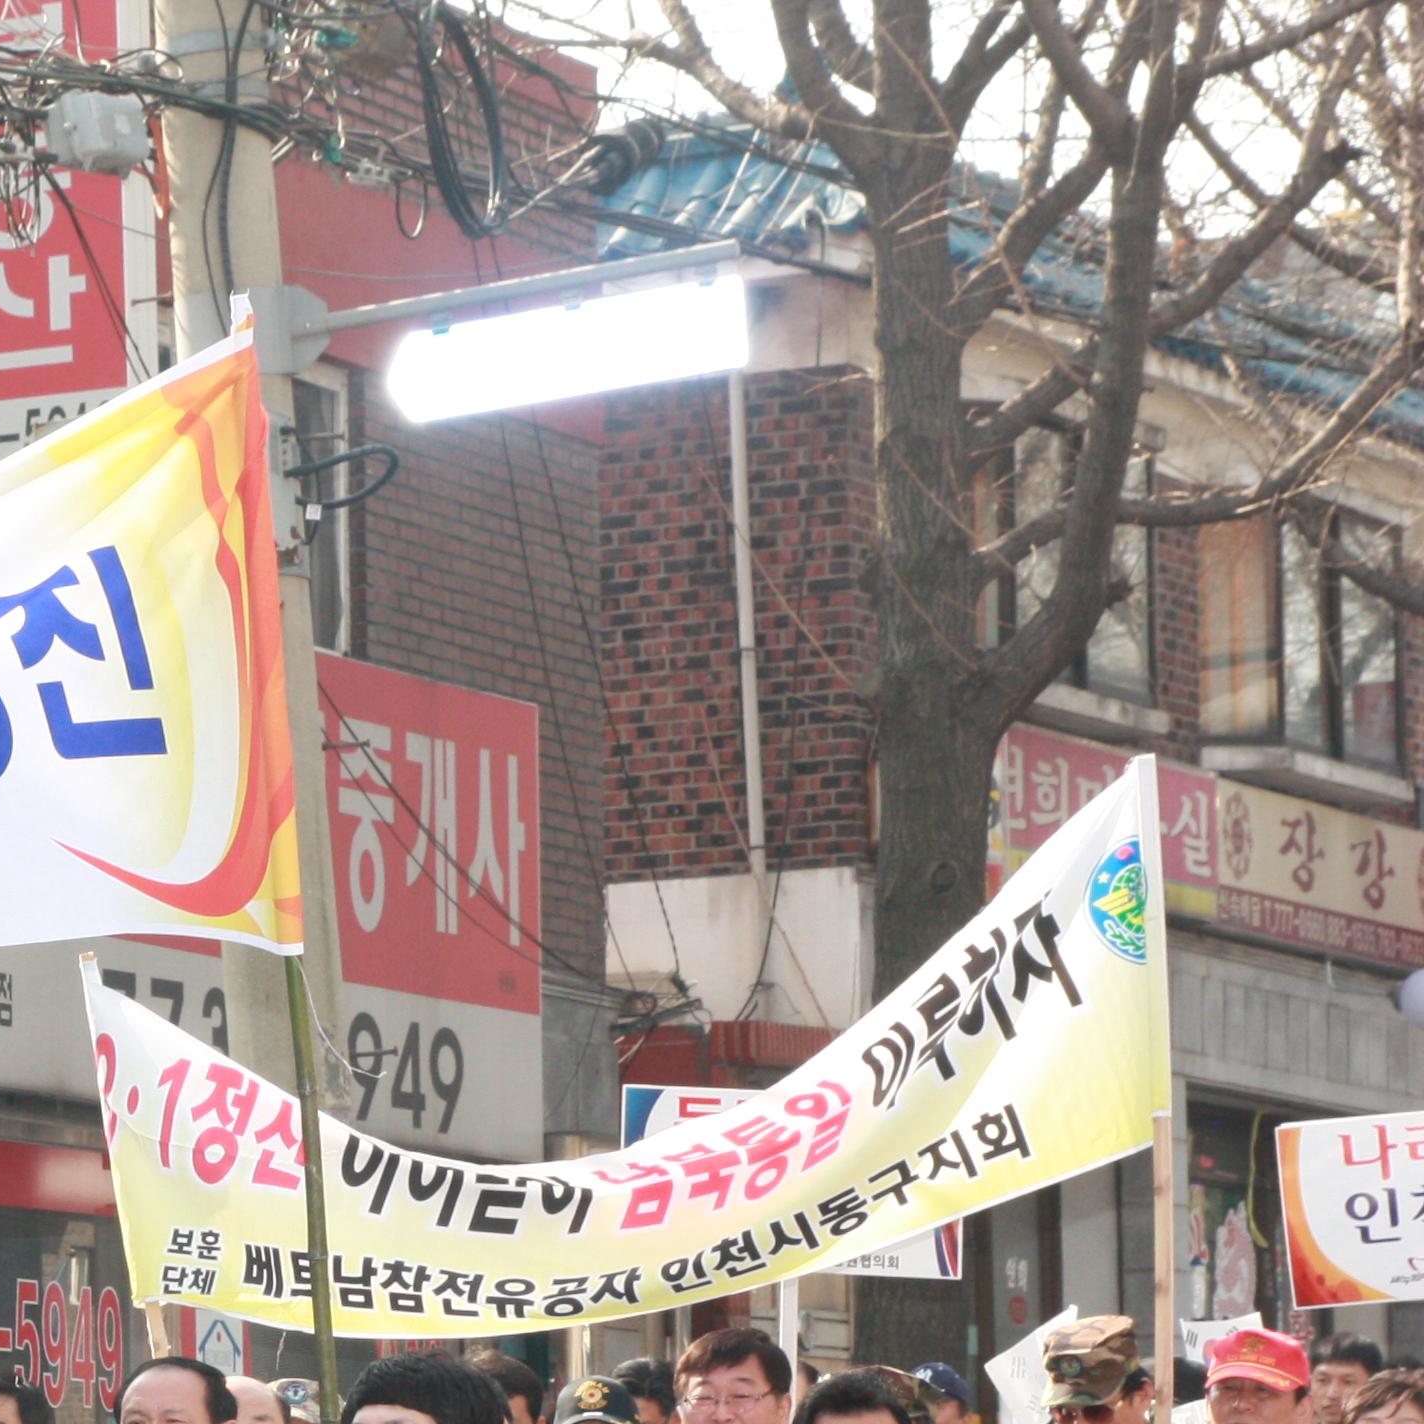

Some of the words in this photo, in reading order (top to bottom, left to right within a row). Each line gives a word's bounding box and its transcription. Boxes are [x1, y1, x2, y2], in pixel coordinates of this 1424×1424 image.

[337, 720, 527, 946] 중개사
[243, 1243, 643, 1320] 베트남참전유공자
[660, 1104, 1032, 1294] 인천시동구지회
[167, 1227, 222, 1261] 보훈
[834, 1254, 900, 1270] 협의회
[161, 1265, 218, 1297] 단체
